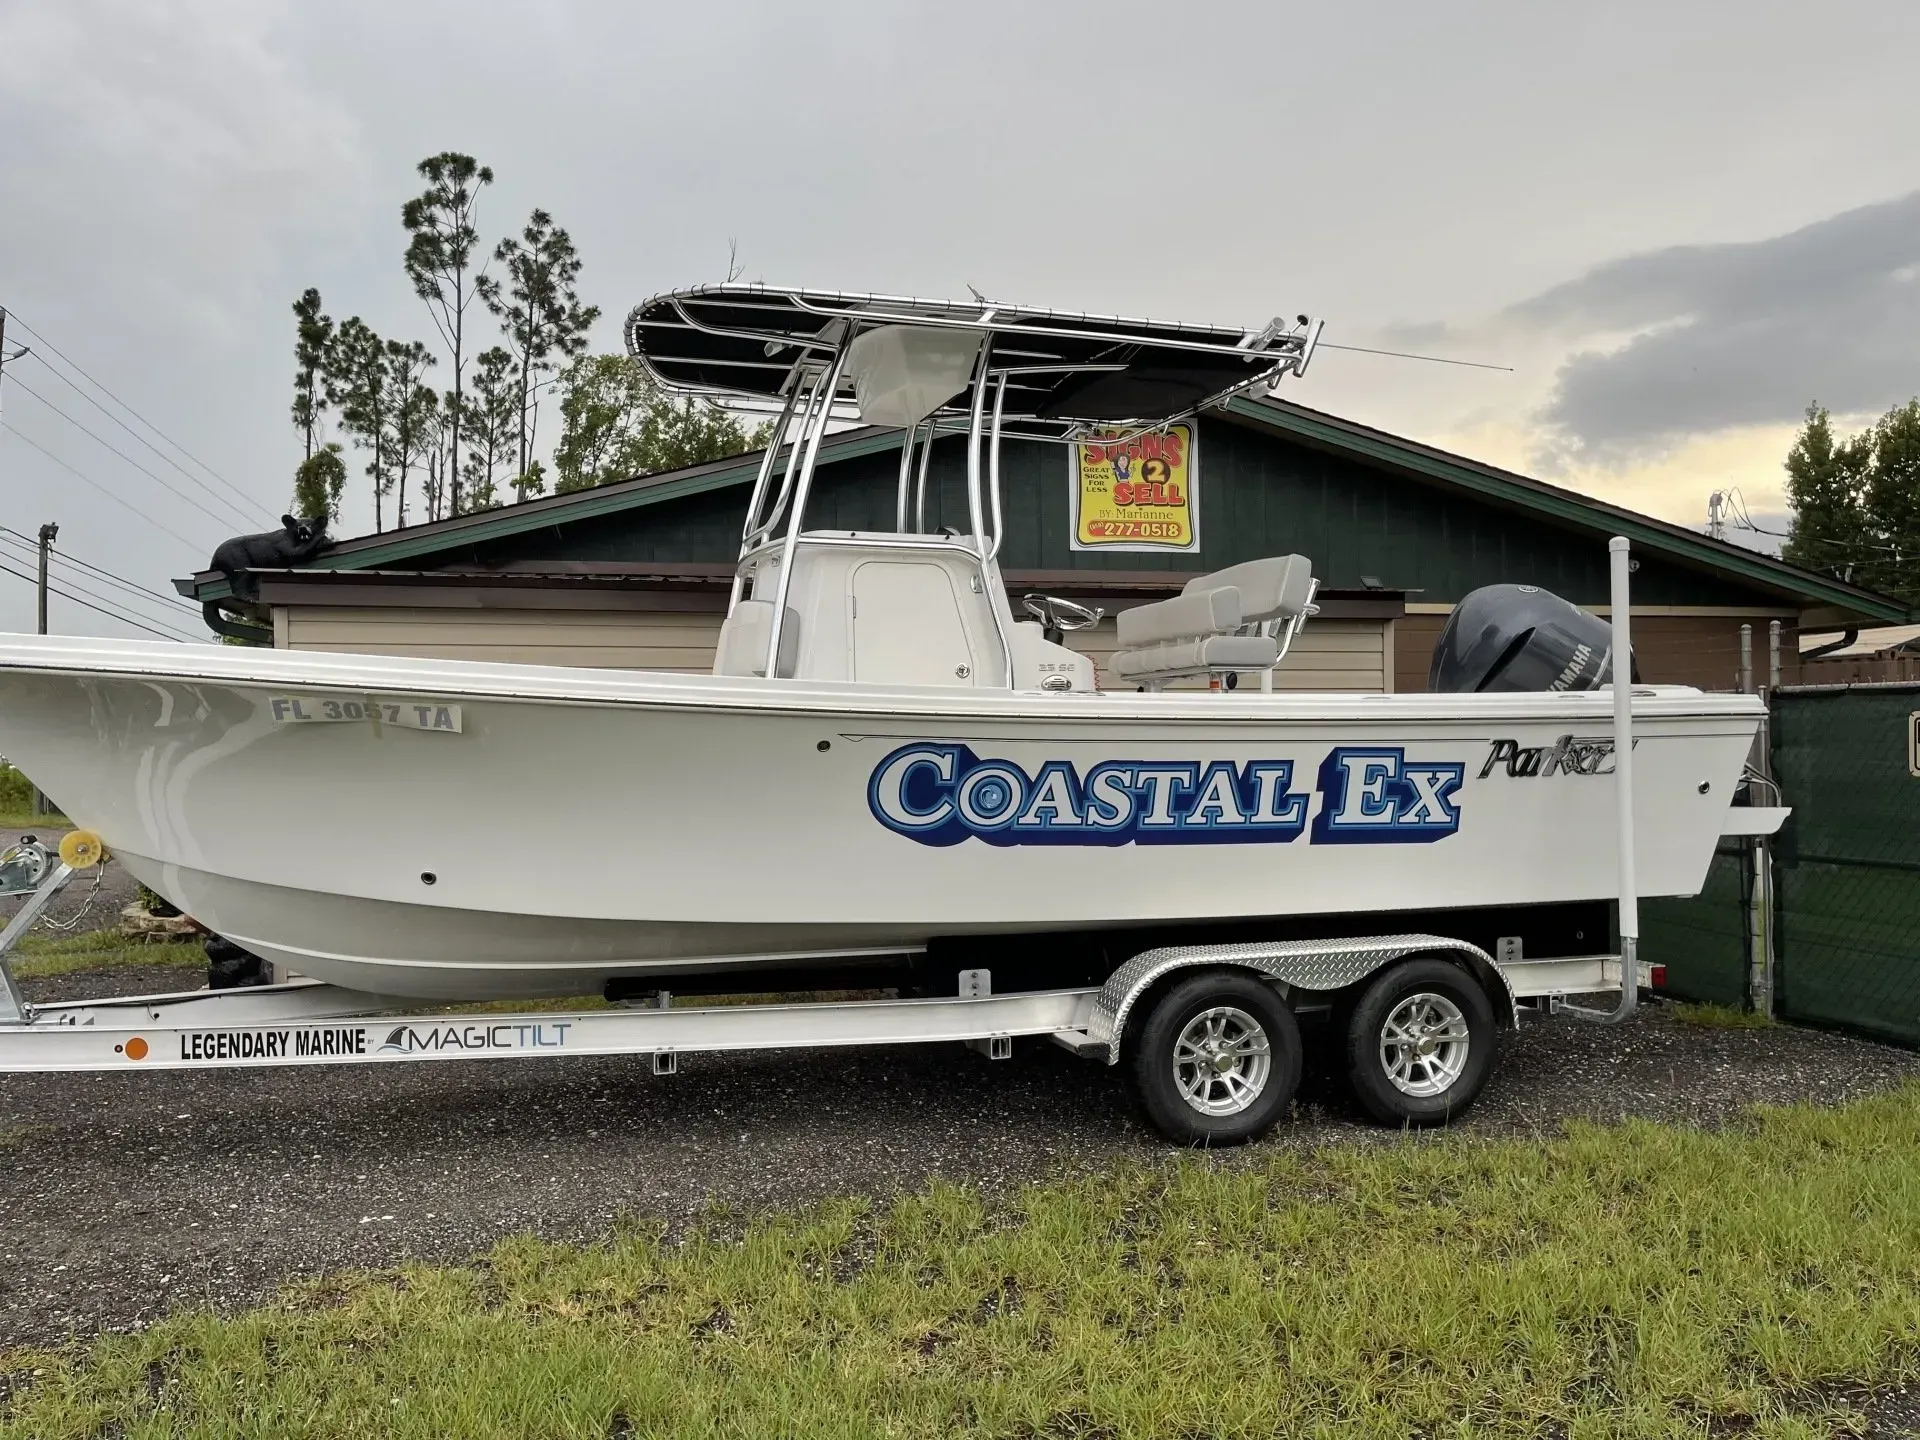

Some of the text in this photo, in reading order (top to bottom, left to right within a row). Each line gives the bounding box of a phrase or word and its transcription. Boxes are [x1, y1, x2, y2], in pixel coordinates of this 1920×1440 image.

[1085, 431, 1183, 468] SIGNS
[1147, 461, 1165, 482] 2
[1112, 482, 1185, 507] SELL
[1116, 508, 1174, 519] Marianne
[1104, 522, 1179, 537] 277-0518
[271, 699, 455, 730] FL 3057 TA
[181, 1028, 366, 1060] LEGENDARY MARINE
[408, 1024, 572, 1050] MAGICTILT
